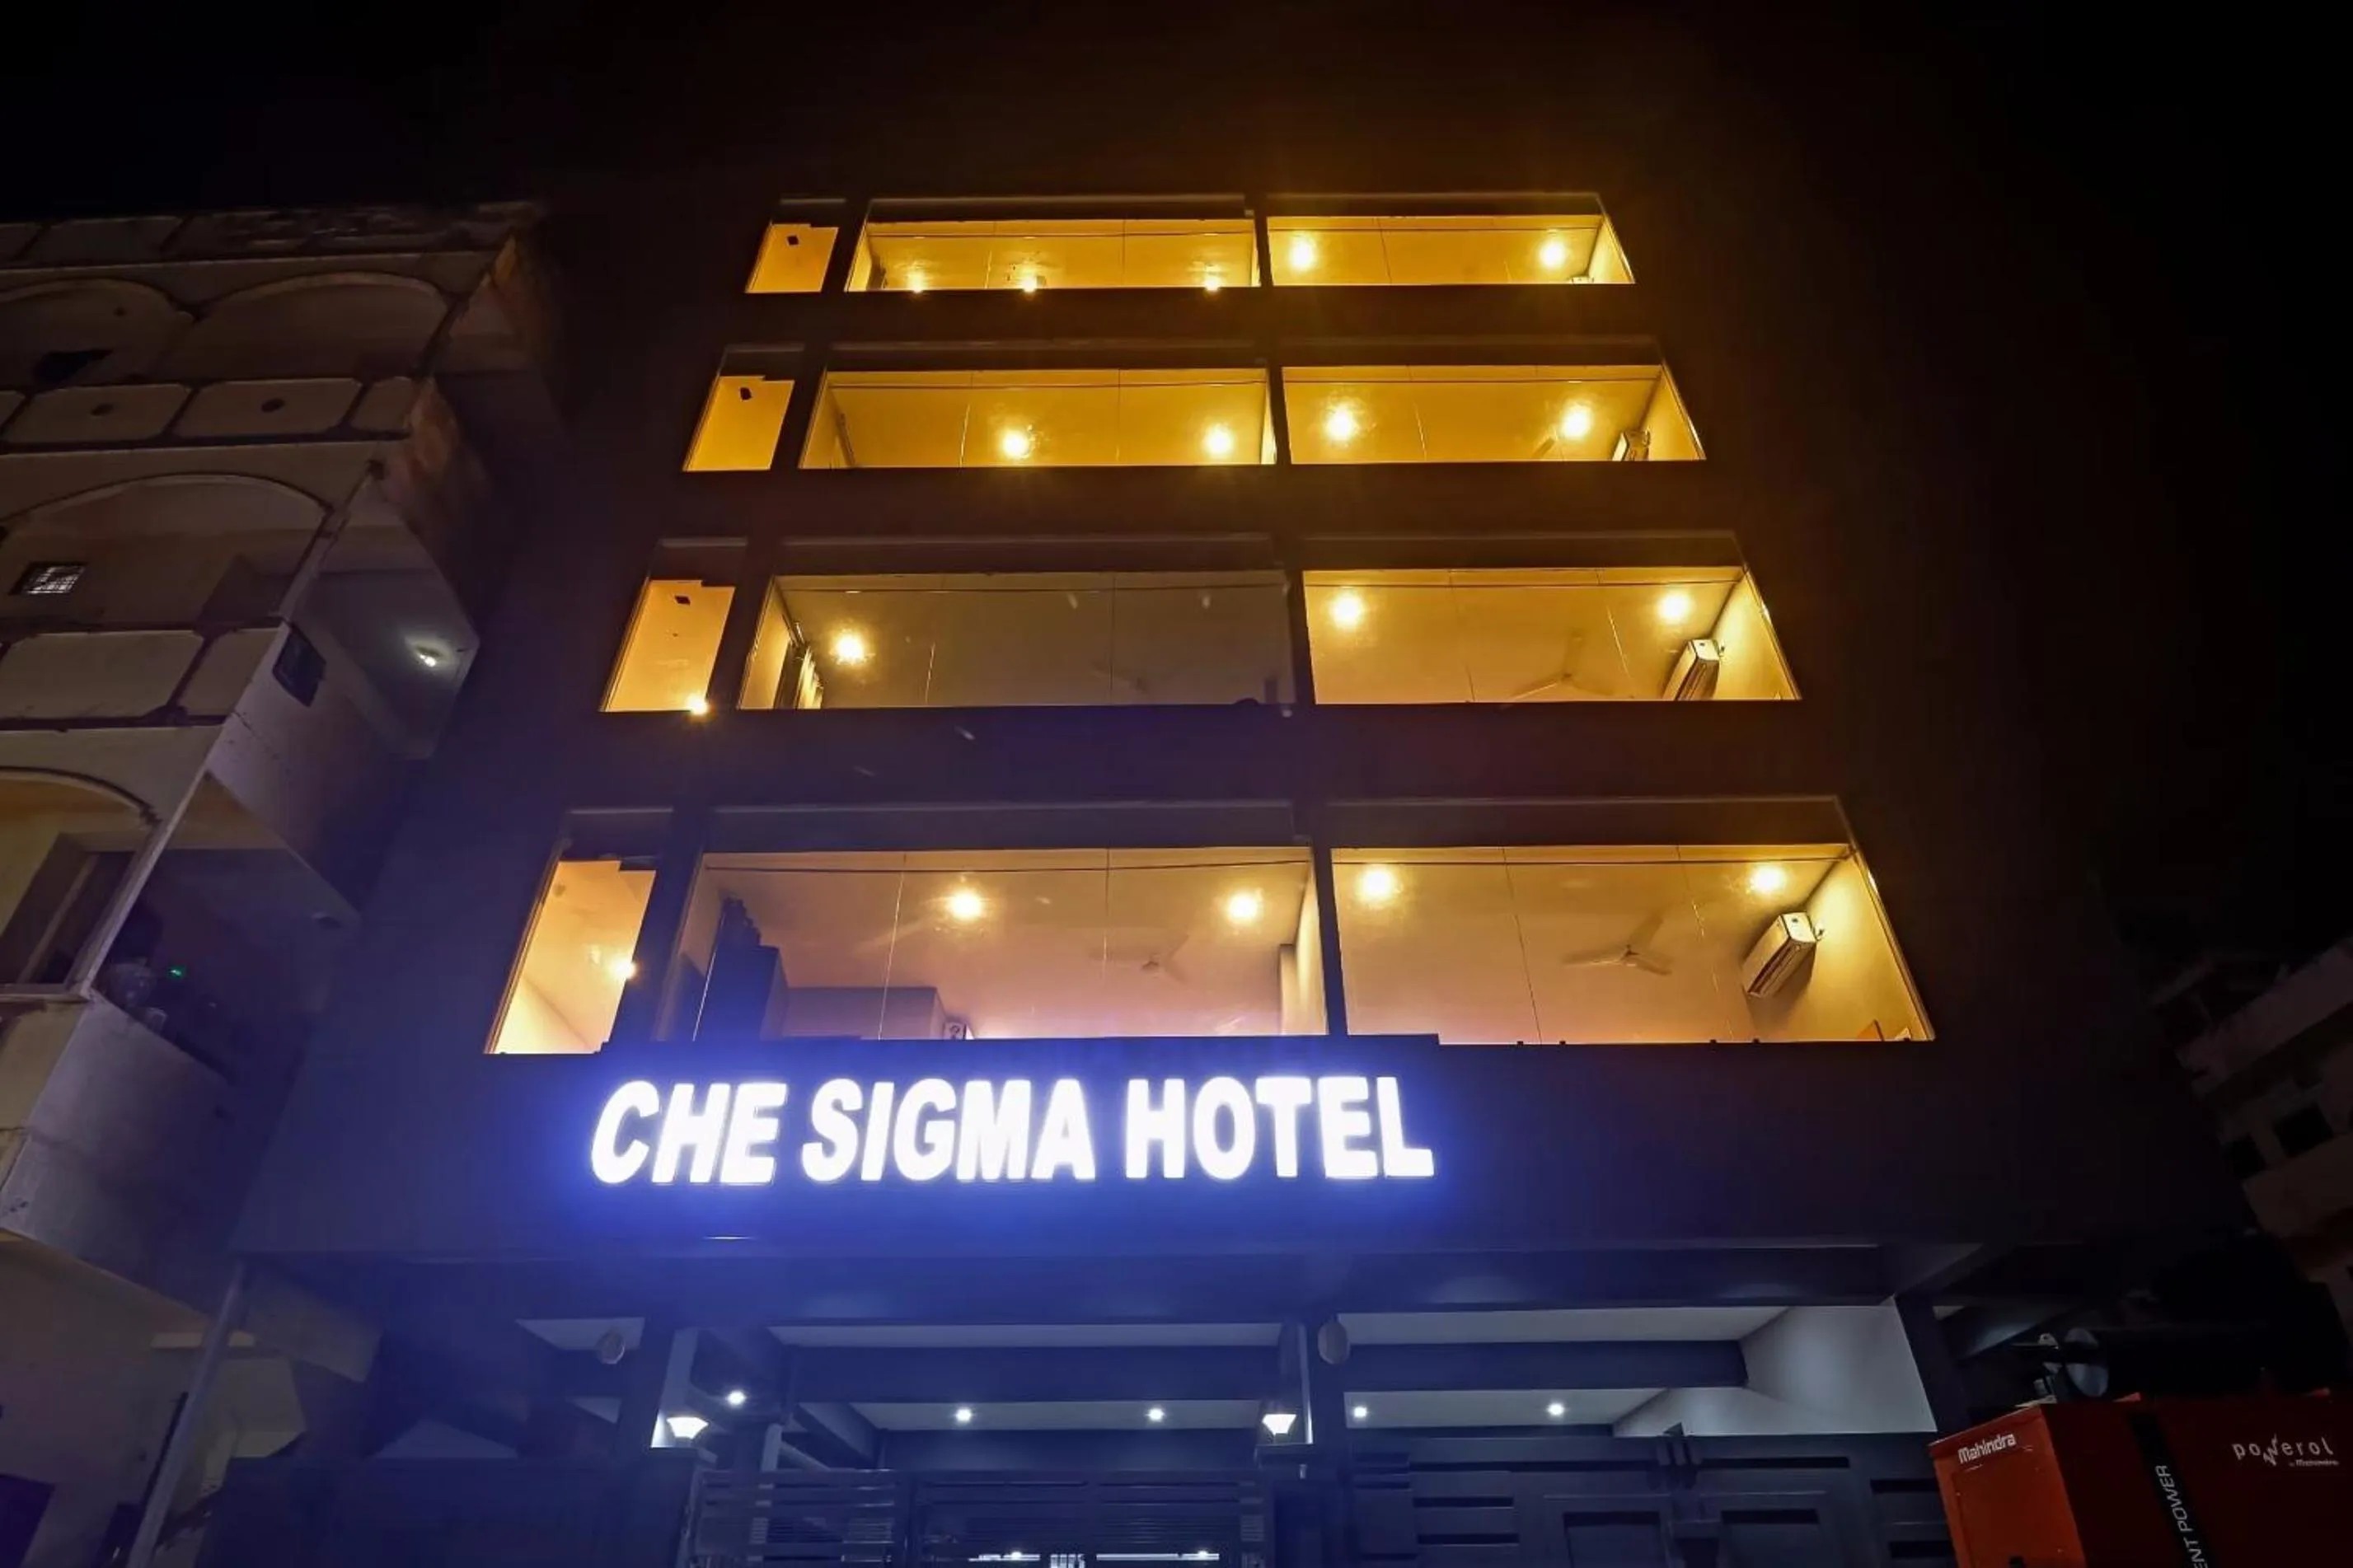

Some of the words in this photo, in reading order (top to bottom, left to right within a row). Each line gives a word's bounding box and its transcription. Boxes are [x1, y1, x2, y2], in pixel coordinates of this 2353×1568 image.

[590, 1080, 787, 1185] CHE
[801, 1078, 1096, 1183] SIGMA
[1123, 1075, 1434, 1180] HOTEL
[1957, 1434, 2017, 1464] Mahindra
[2232, 1433, 2334, 1466] powerol
[2155, 1465, 2193, 1532] POWER
